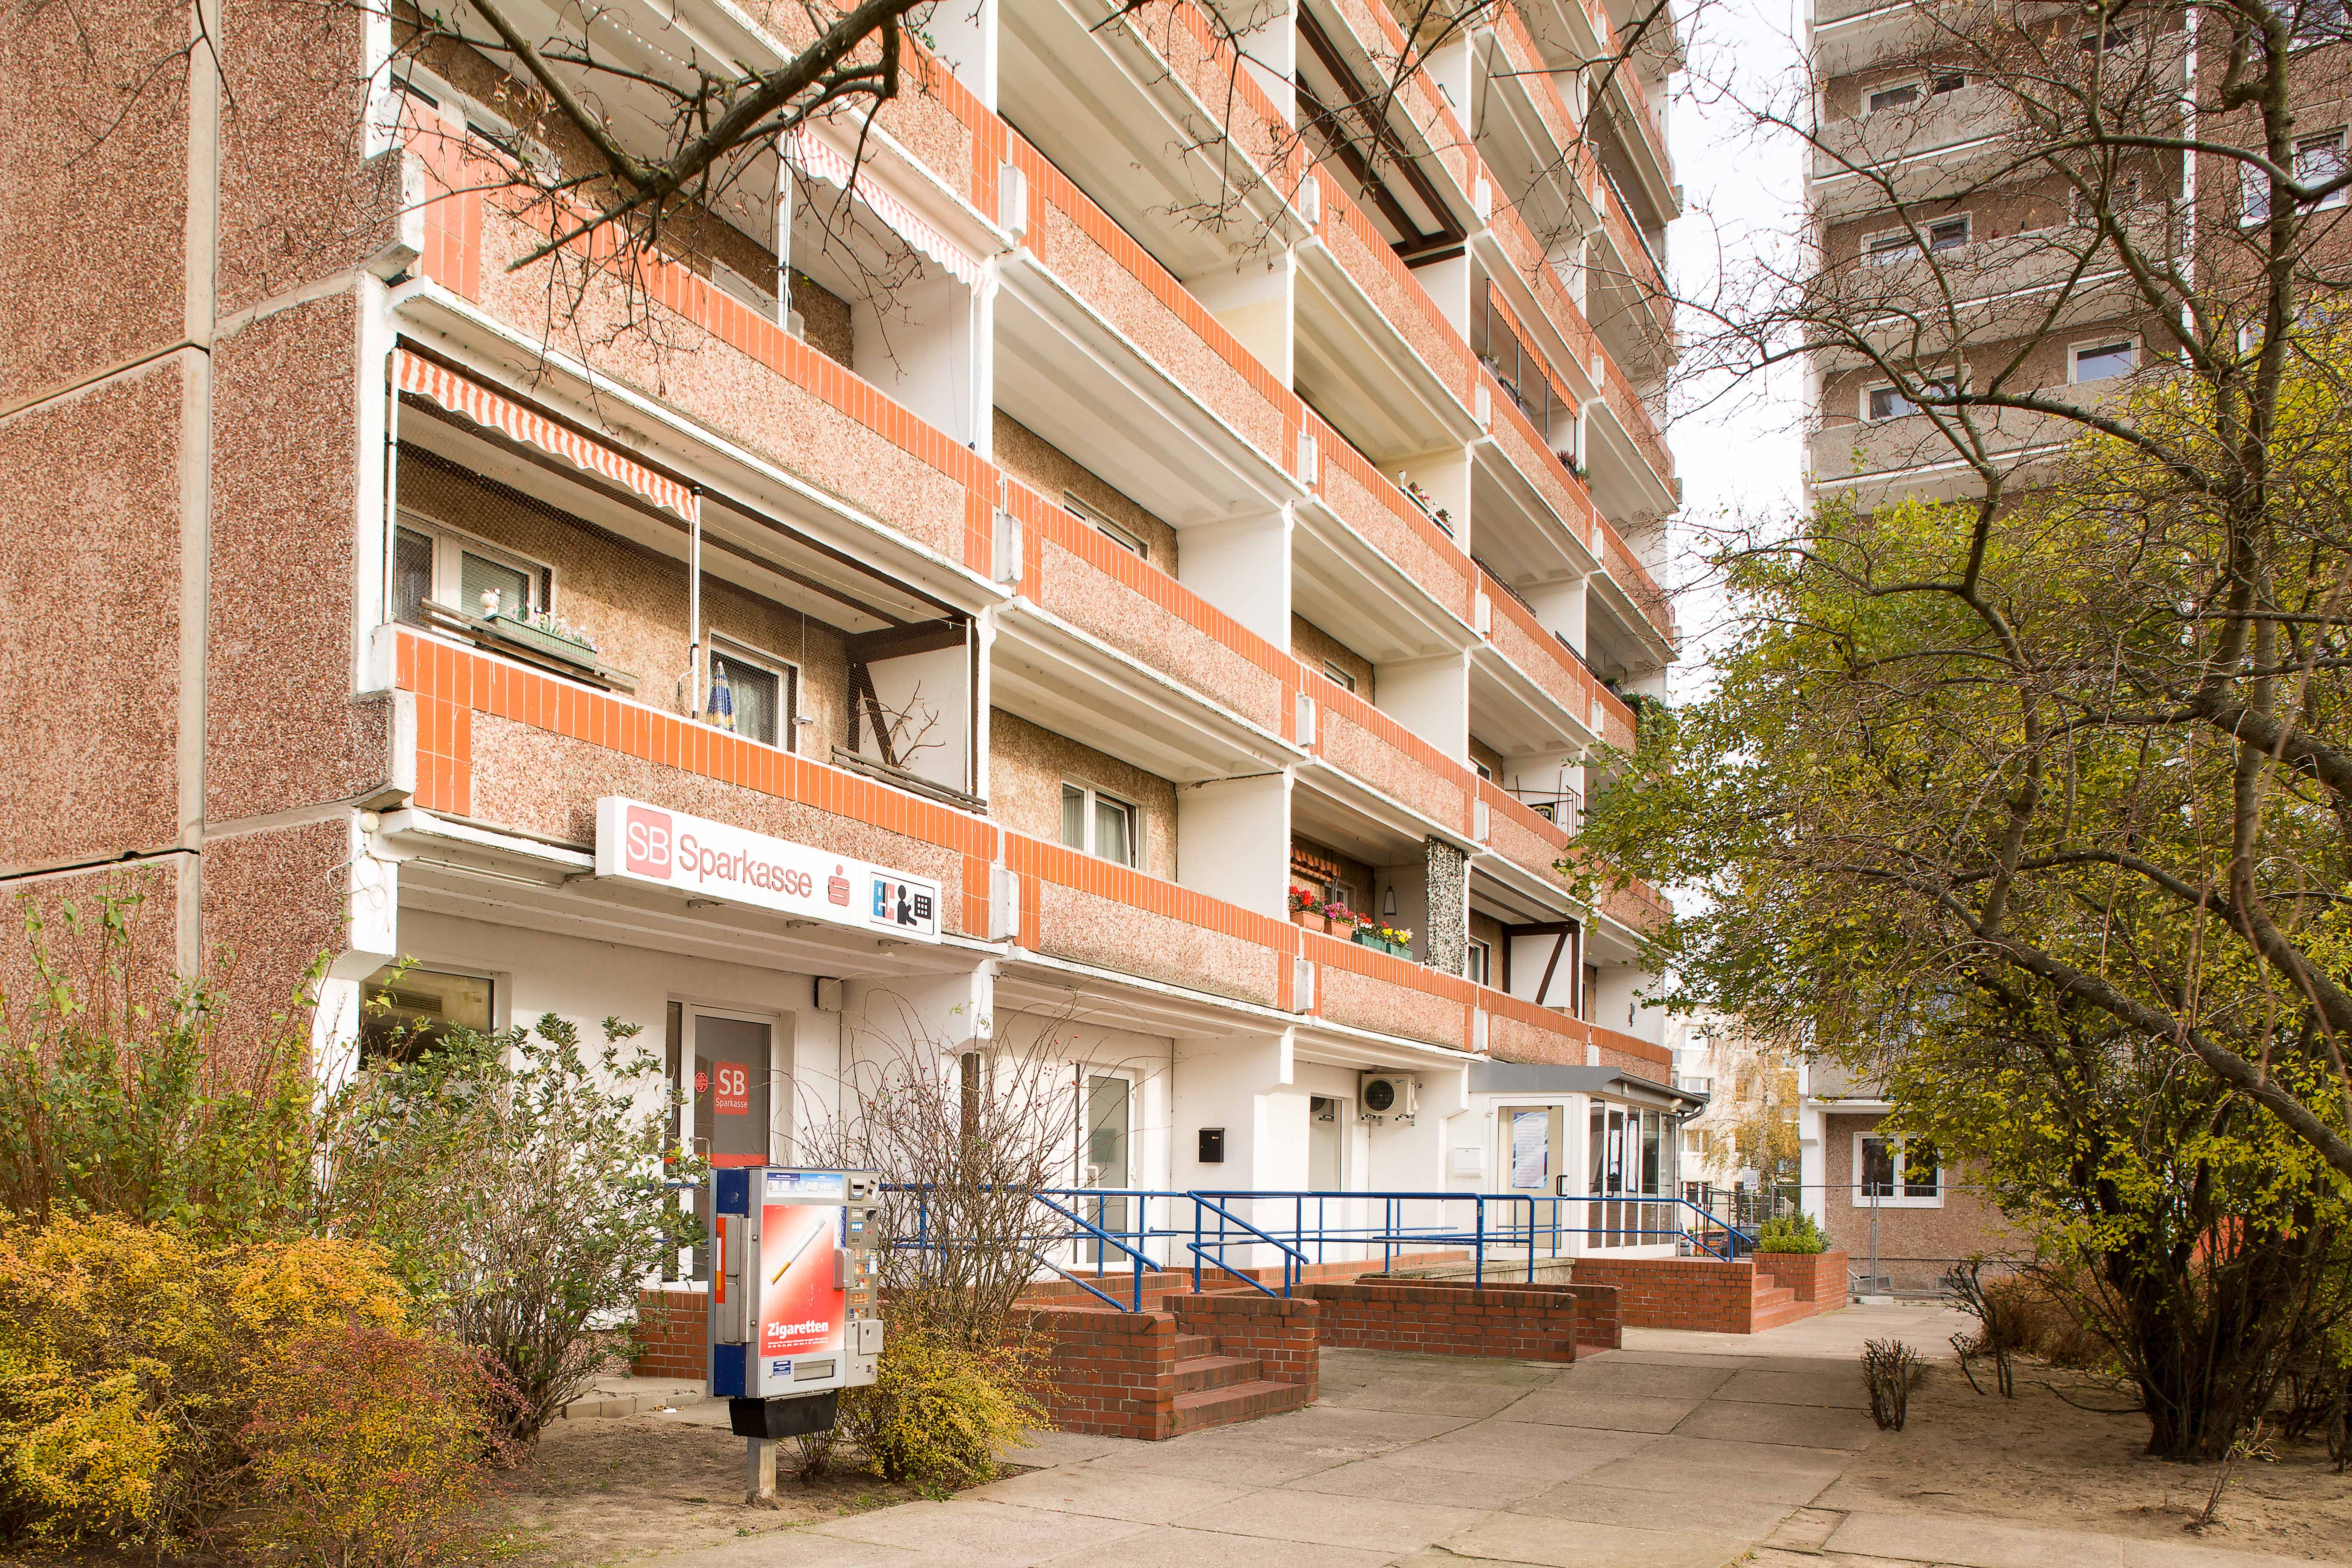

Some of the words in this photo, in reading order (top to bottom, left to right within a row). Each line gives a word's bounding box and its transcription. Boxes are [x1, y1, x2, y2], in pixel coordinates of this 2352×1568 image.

[627, 821, 670, 865] SB
[679, 834, 812, 898] Sparkasse
[719, 1069, 745, 1095] SB
[716, 1098, 748, 1108] Sparkasse
[768, 1320, 828, 1339] Zigaretten
